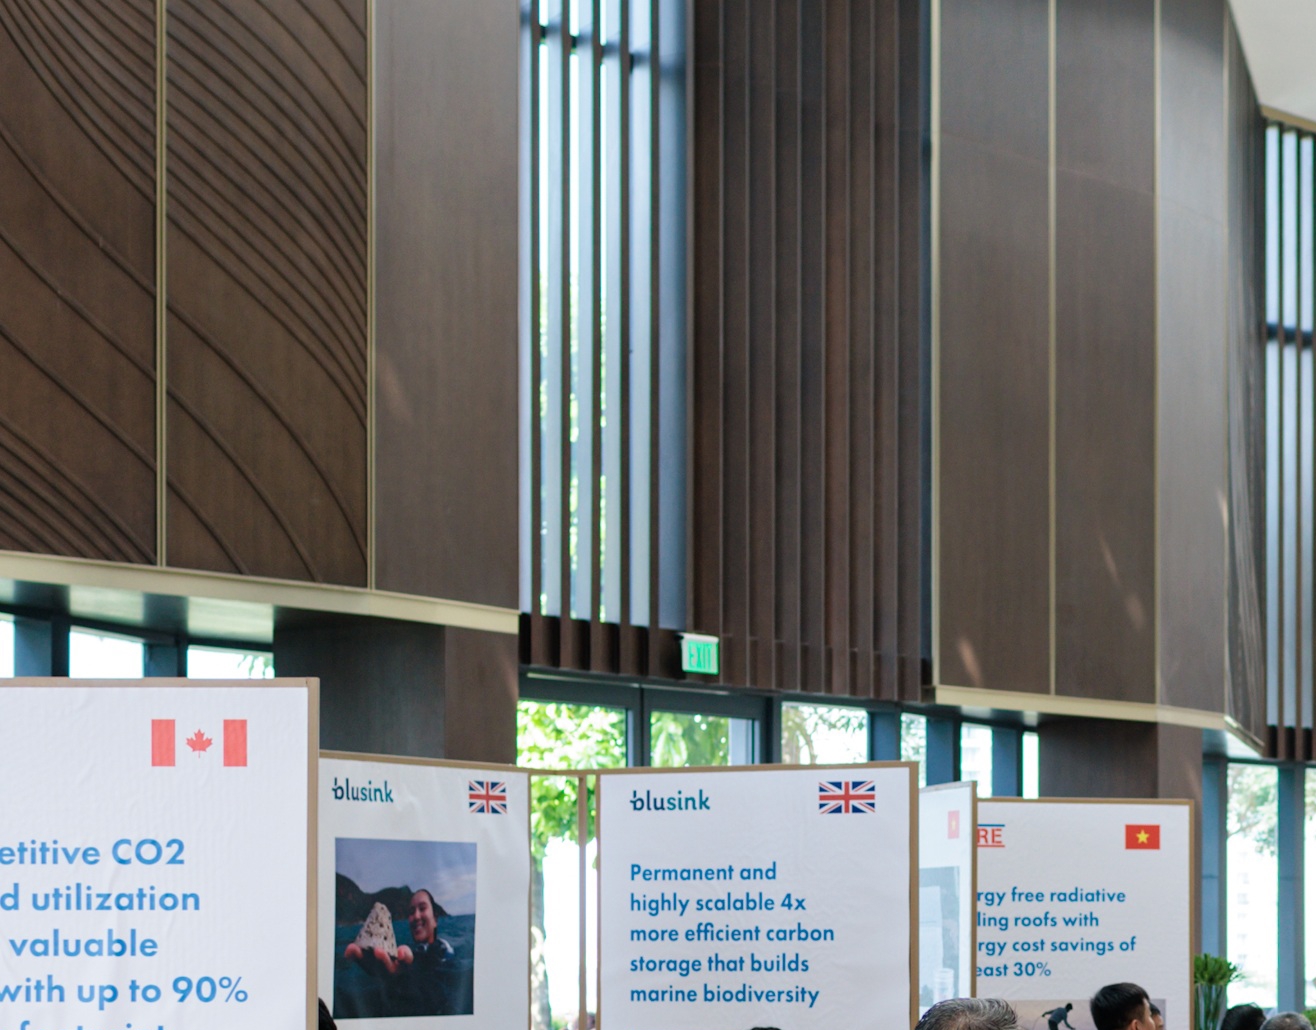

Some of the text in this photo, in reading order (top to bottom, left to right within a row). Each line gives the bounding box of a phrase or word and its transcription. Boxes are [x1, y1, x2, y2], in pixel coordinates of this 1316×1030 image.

[688, 642, 712, 668] EXIT
[332, 777, 394, 803] blusink
[630, 789, 711, 811] blusink
[112, 838, 185, 865] CO2
[630, 861, 776, 881] Permanent and
[32, 883, 200, 911] utilization
[630, 892, 806, 917] highly scalable 4x
[1011, 886, 1044, 902] free
[1050, 887, 1126, 903] radiative
[1014, 911, 1057, 927] roofs
[1063, 912, 1099, 927] with
[9, 929, 158, 957] valuable
[630, 922, 835, 942] more efficient carbon
[1012, 939, 1046, 952] cost
[1050, 938, 1114, 956] savings
[1119, 936, 1136, 951] of
[630, 953, 809, 977] storage that builds
[1013, 962, 1051, 977] 30%
[0, 974, 249, 1011] with up to 90%
[630, 983, 820, 1008] marine biodiversity
